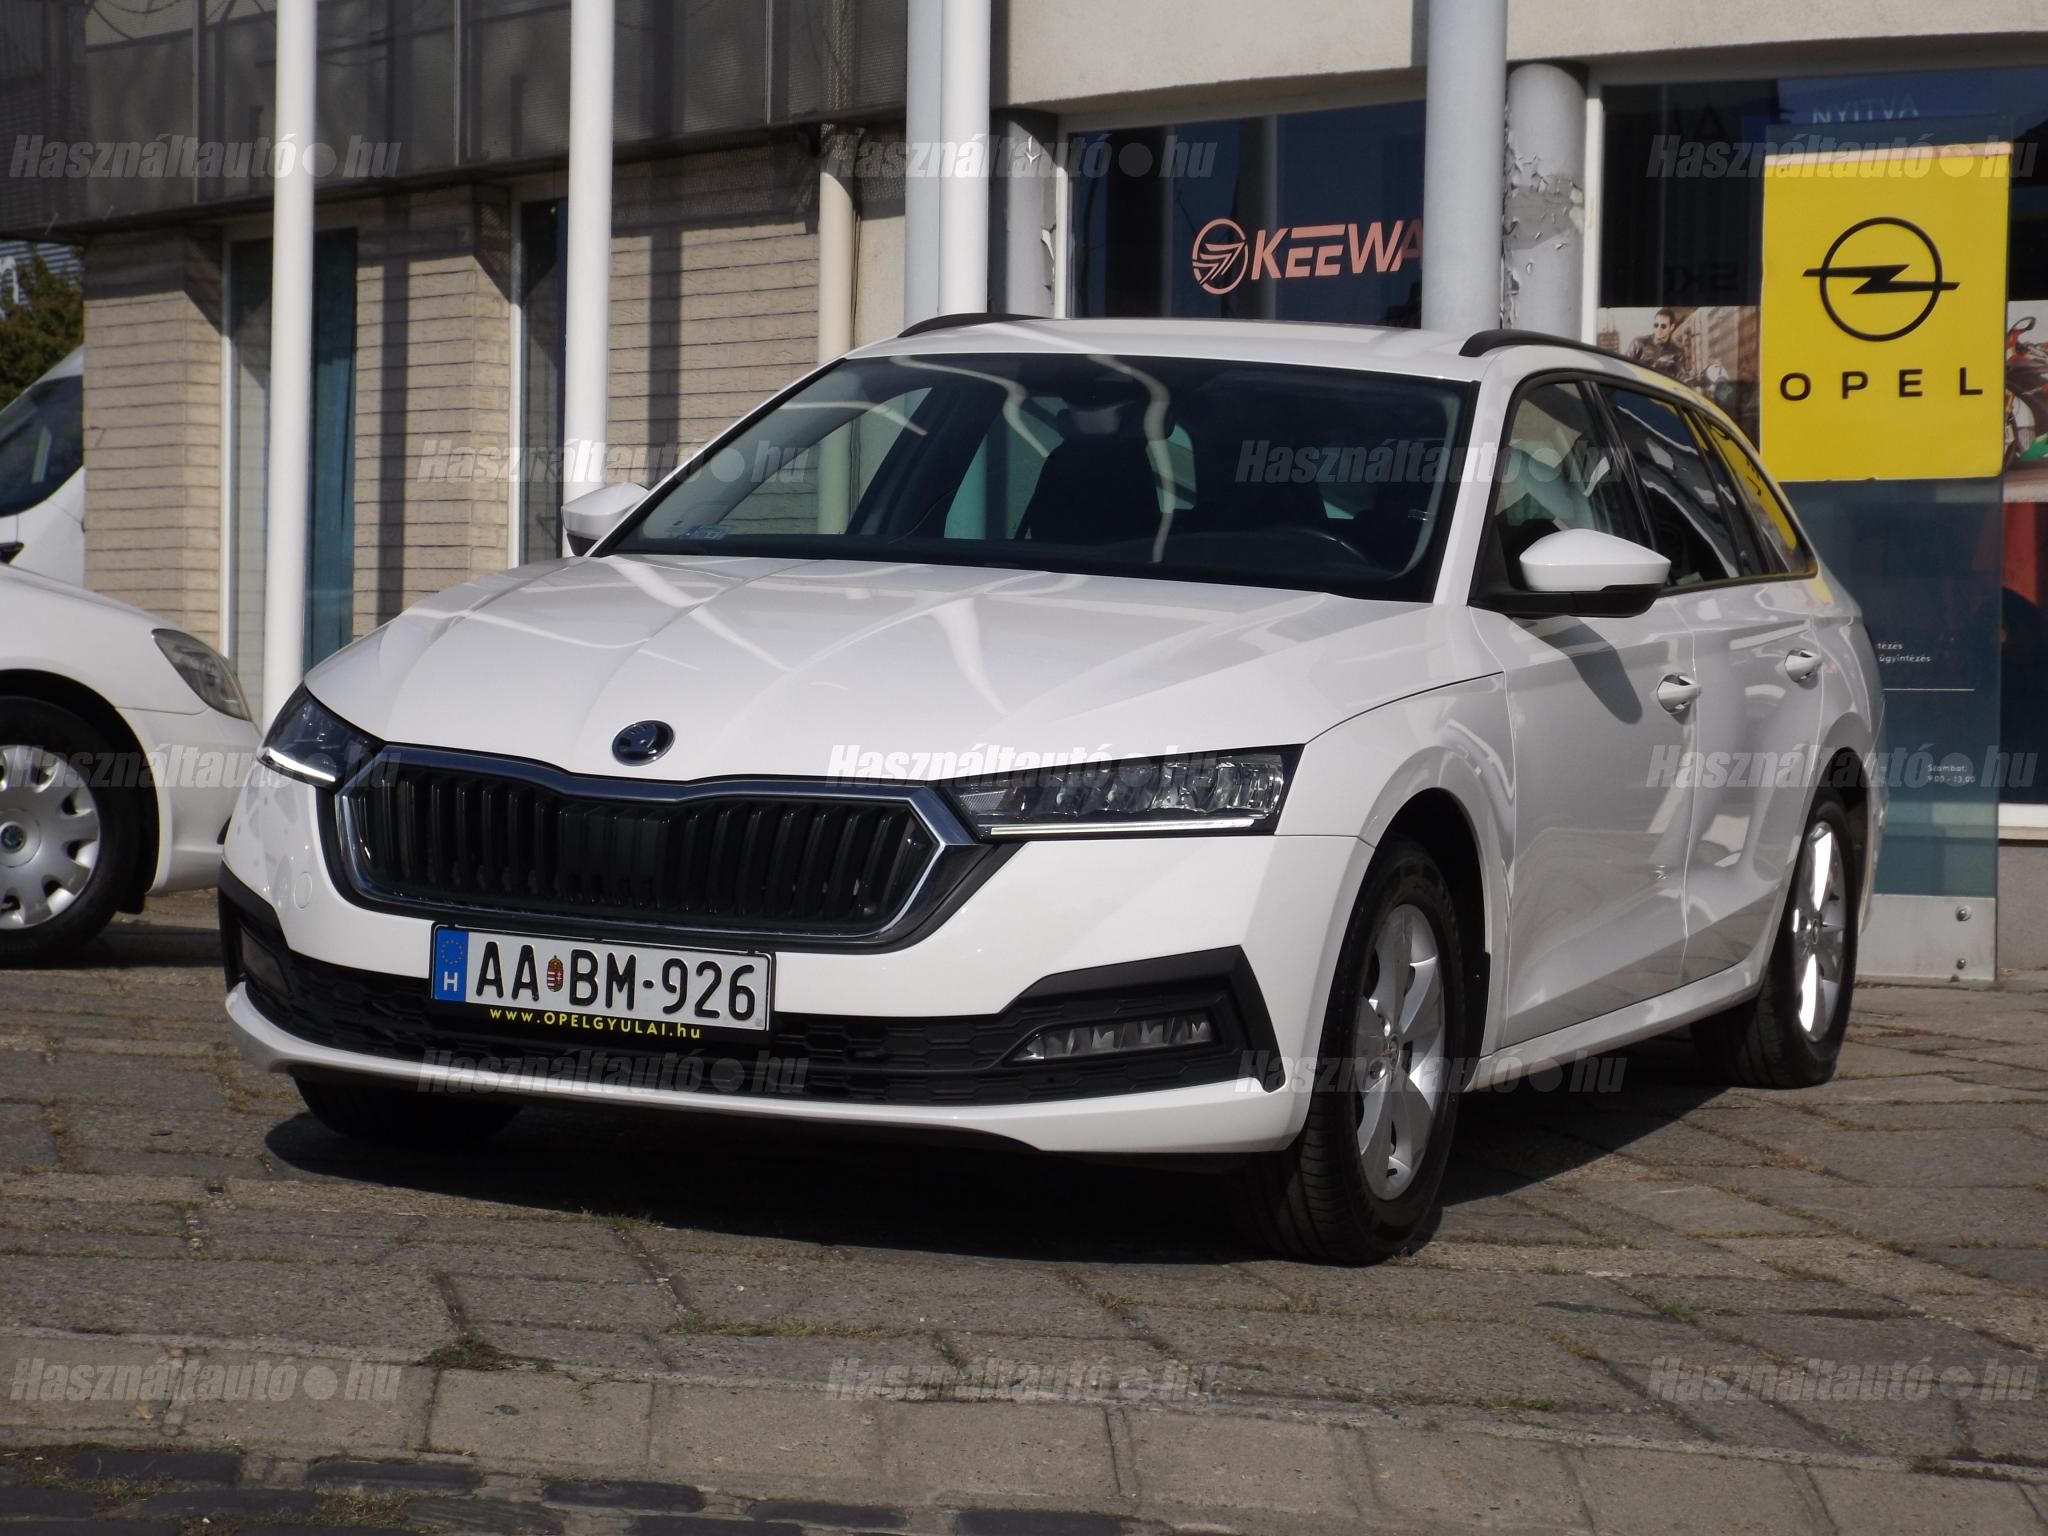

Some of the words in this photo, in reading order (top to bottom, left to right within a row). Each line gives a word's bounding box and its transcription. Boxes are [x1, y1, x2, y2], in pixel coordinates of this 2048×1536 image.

[1780, 368, 1984, 401] OPEL
[443, 971, 458, 992] H
[475, 941, 540, 1002] AA
[568, 948, 756, 1021] BM-926
[489, 1008, 702, 1040] www.OPELGYULAI.hu
